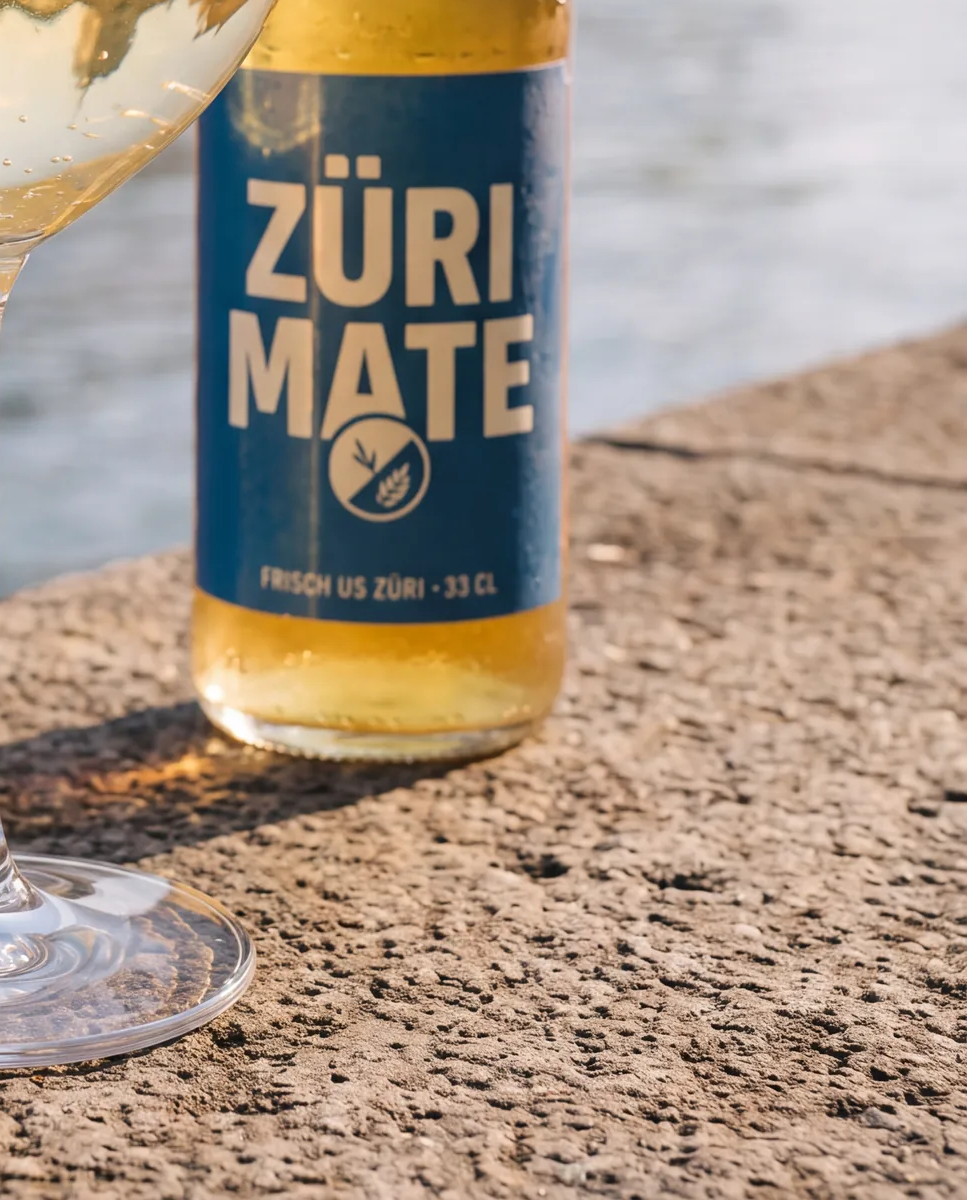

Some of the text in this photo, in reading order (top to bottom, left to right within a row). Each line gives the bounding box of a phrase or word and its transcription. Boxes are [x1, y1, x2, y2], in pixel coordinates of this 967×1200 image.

[246, 154, 514, 307] ZÜRI
[228, 309, 534, 442] MATE
[260, 564, 331, 598] FRISCH
[337, 574, 368, 600] US
[373, 572, 425, 601] ZÜRI
[444, 574, 470, 598] 33
[474, 571, 498, 595] CL
